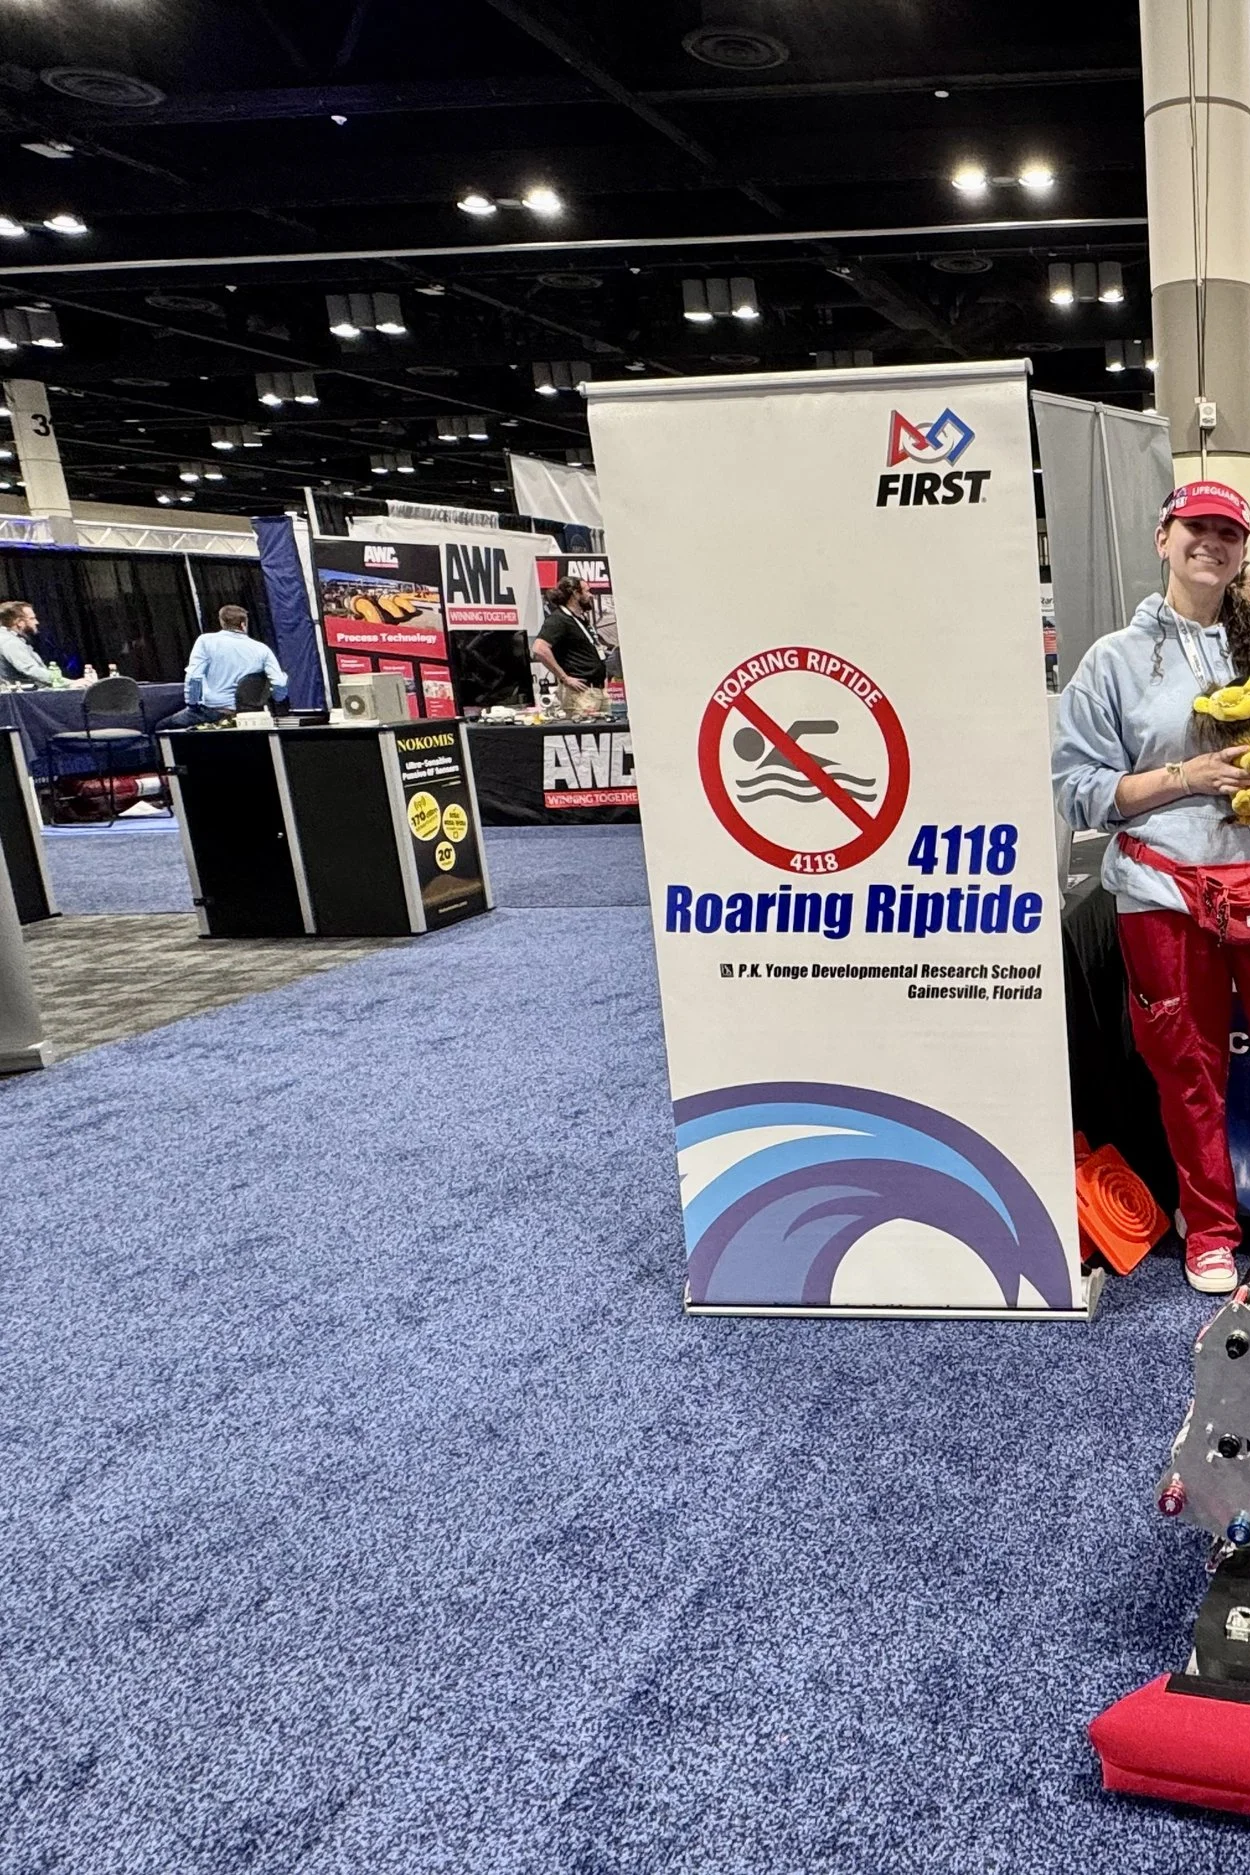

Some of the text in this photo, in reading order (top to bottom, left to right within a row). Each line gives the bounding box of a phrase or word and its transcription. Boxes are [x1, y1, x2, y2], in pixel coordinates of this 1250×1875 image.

[31, 413, 51, 437] 3
[1191, 486, 1241, 507] LIFEGUARD
[364, 545, 398, 564] AWC
[446, 543, 516, 605] AWC
[568, 561, 609, 582] AWC
[450, 611, 517, 623] WINNING TOGETHER
[336, 632, 437, 644] Process Technology
[713, 649, 883, 710] ROARING RIPTIDE
[396, 733, 455, 752] NOKOMIS
[543, 732, 636, 790] AWC
[402, 769, 427, 781] Passive
[435, 765, 459, 775] Sensors
[548, 793, 639, 807] WINNING TOGETHE
[908, 824, 1019, 876] 4118
[789, 852, 839, 873] 4118
[665, 883, 1043, 940] Roaring Riptide
[738, 963, 1042, 980] P.K. Yonge Developmental Research School
[907, 984, 1043, 1001] Gainesville, Florida
